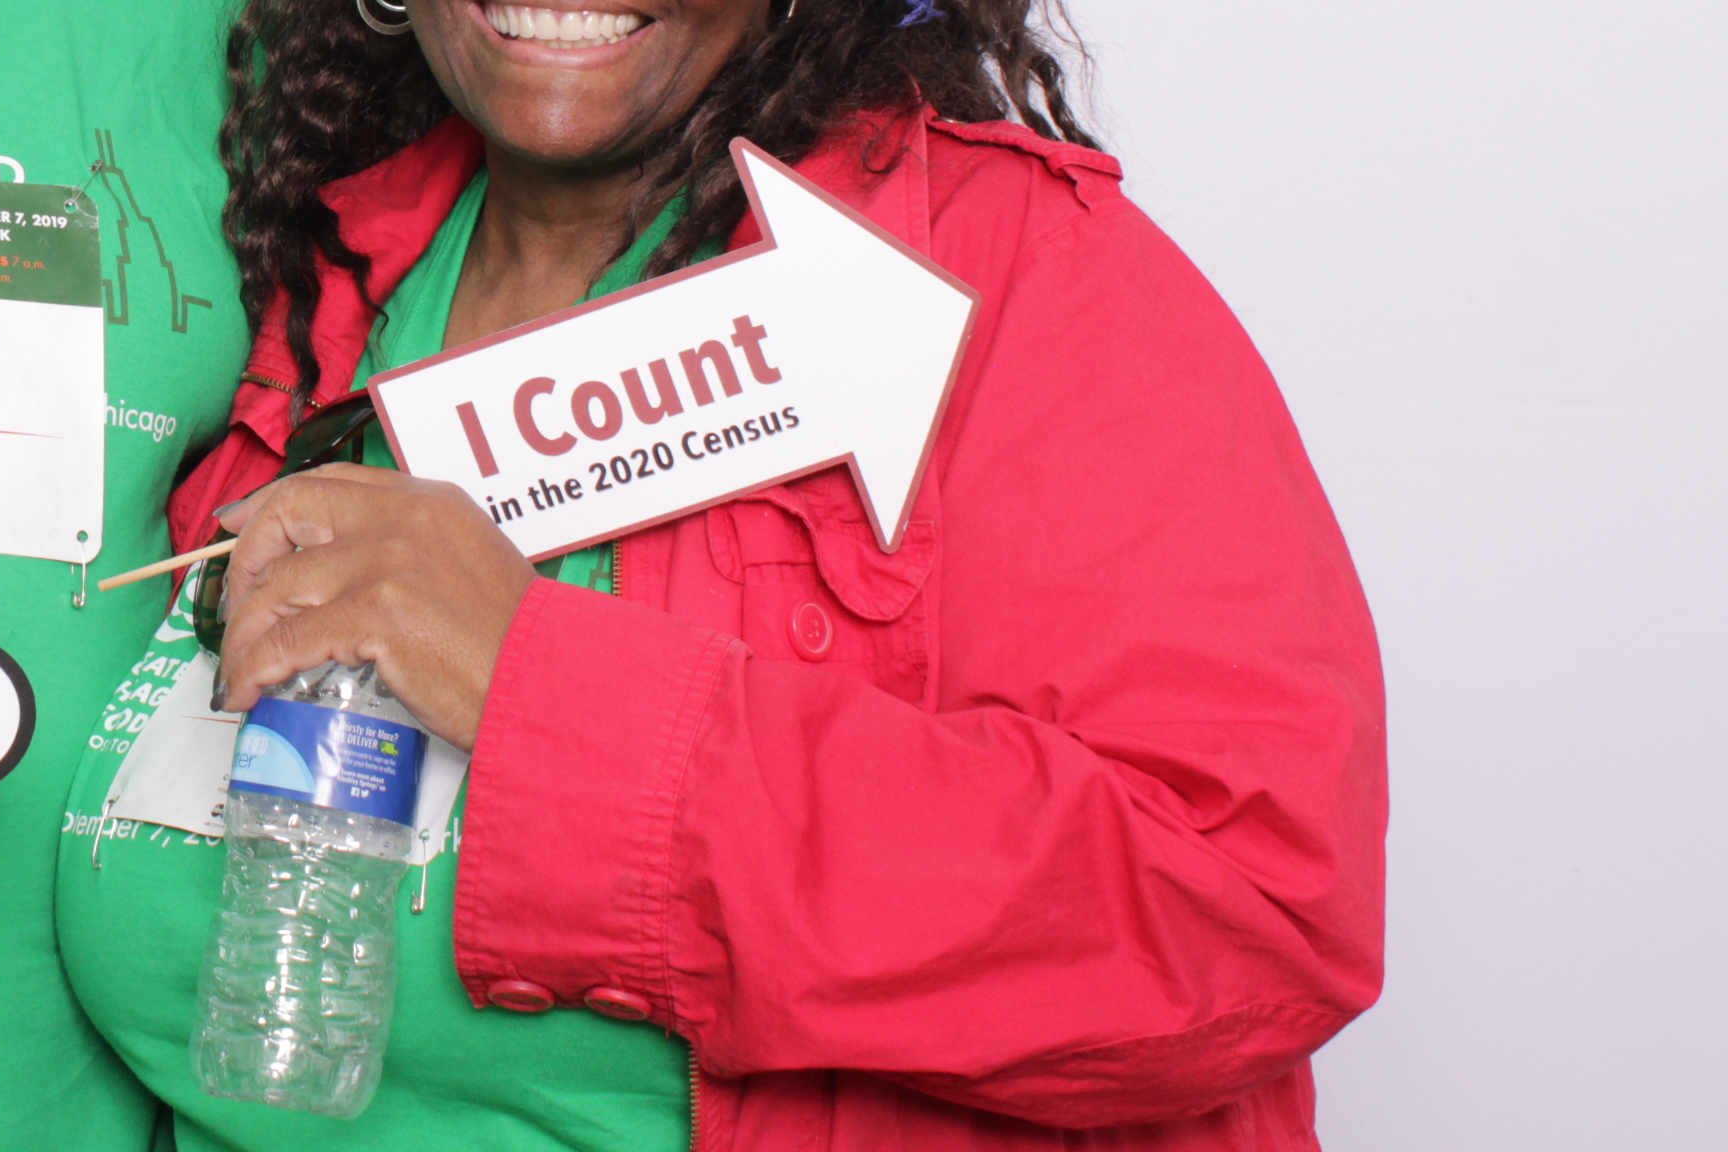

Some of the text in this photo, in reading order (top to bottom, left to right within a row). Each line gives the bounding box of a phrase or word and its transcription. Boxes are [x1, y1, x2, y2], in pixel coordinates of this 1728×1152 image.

[14, 212, 27, 227] 7,
[31, 213, 68, 229] 2019
[12, 256, 20, 267] 7
[455, 314, 783, 479] I Count
[104, 392, 177, 442] hicago
[486, 405, 801, 525] in the 2020 Census
[347, 733, 379, 750] DELIVER
[365, 726, 376, 738] for
[377, 729, 399, 743] More?
[240, 734, 269, 755] IFIED
[233, 752, 257, 769] ter
